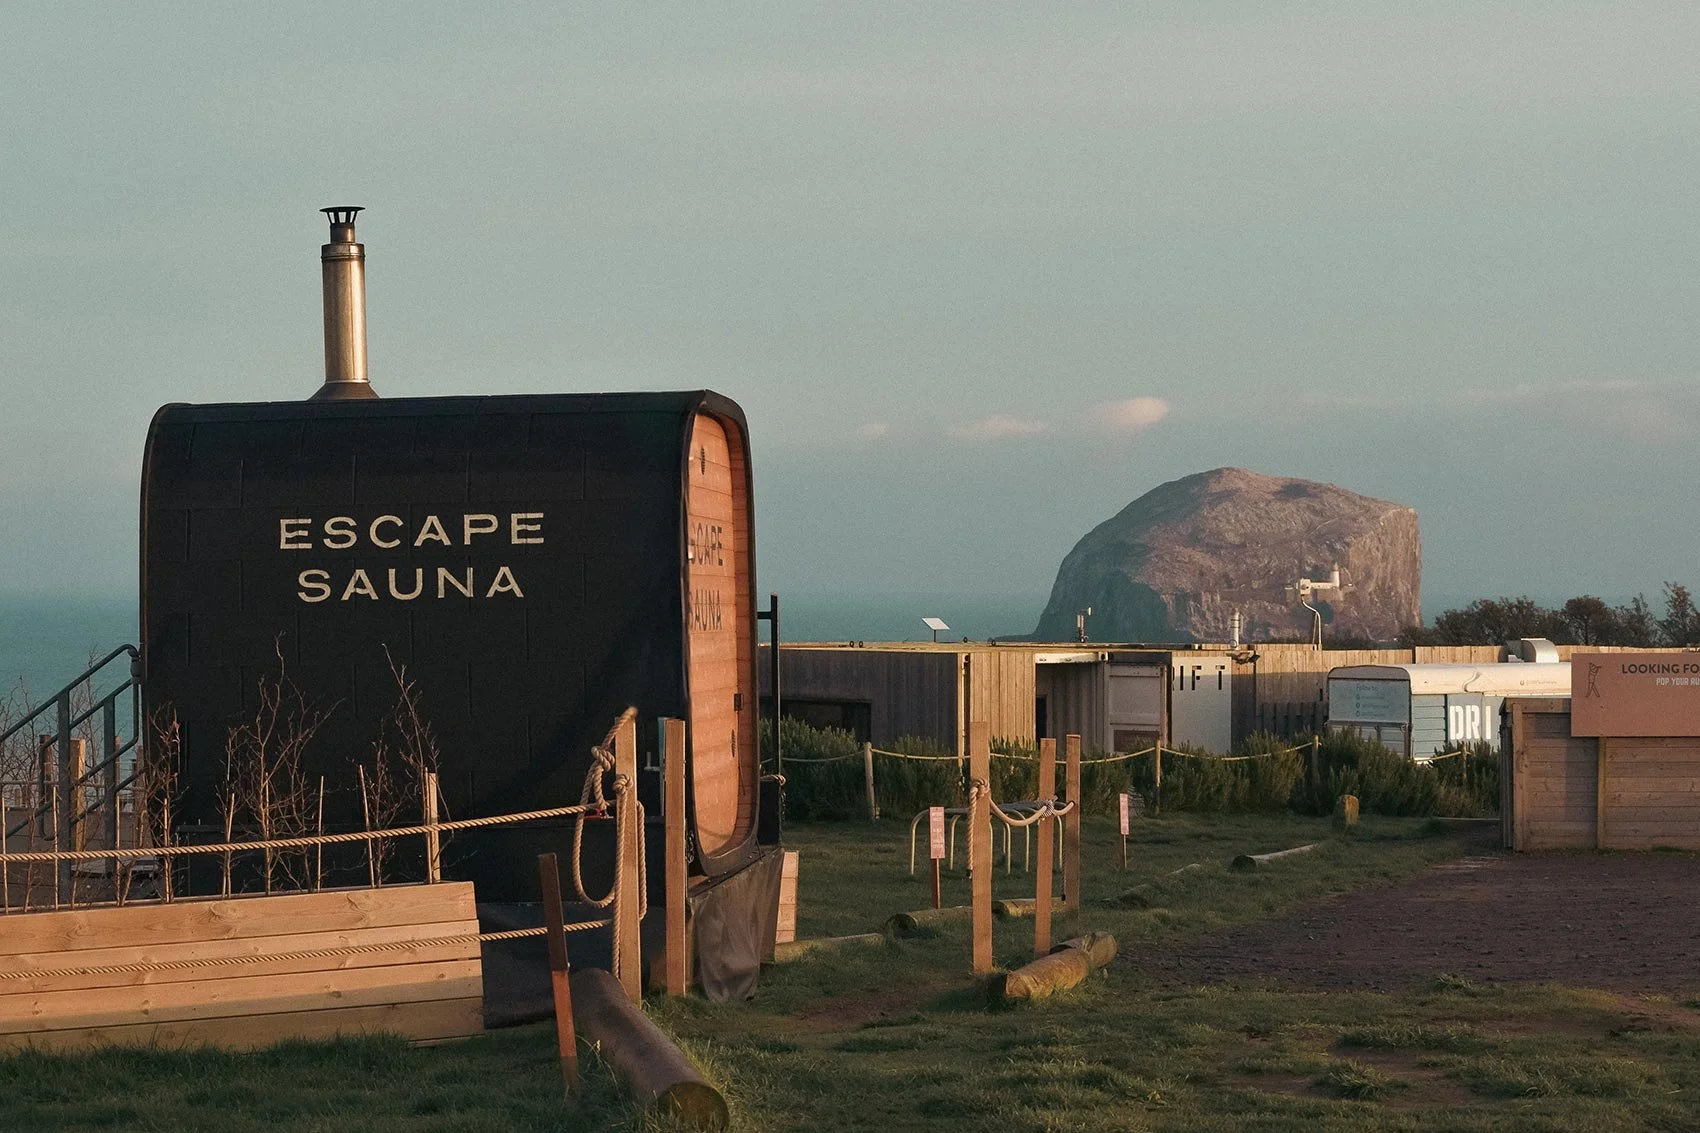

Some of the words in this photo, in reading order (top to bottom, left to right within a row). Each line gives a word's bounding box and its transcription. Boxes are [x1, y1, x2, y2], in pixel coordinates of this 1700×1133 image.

[279, 513, 545, 550] ESCAPE
[296, 566, 525, 603] SAUNA
[1172, 665, 1226, 691] IFT
[1621, 663, 1680, 674] LOOKING
[1683, 663, 1700, 674] FO
[1656, 677, 1670, 687] POP
[1671, 677, 1689, 687] YOUR
[1449, 704, 1492, 740] DRI
